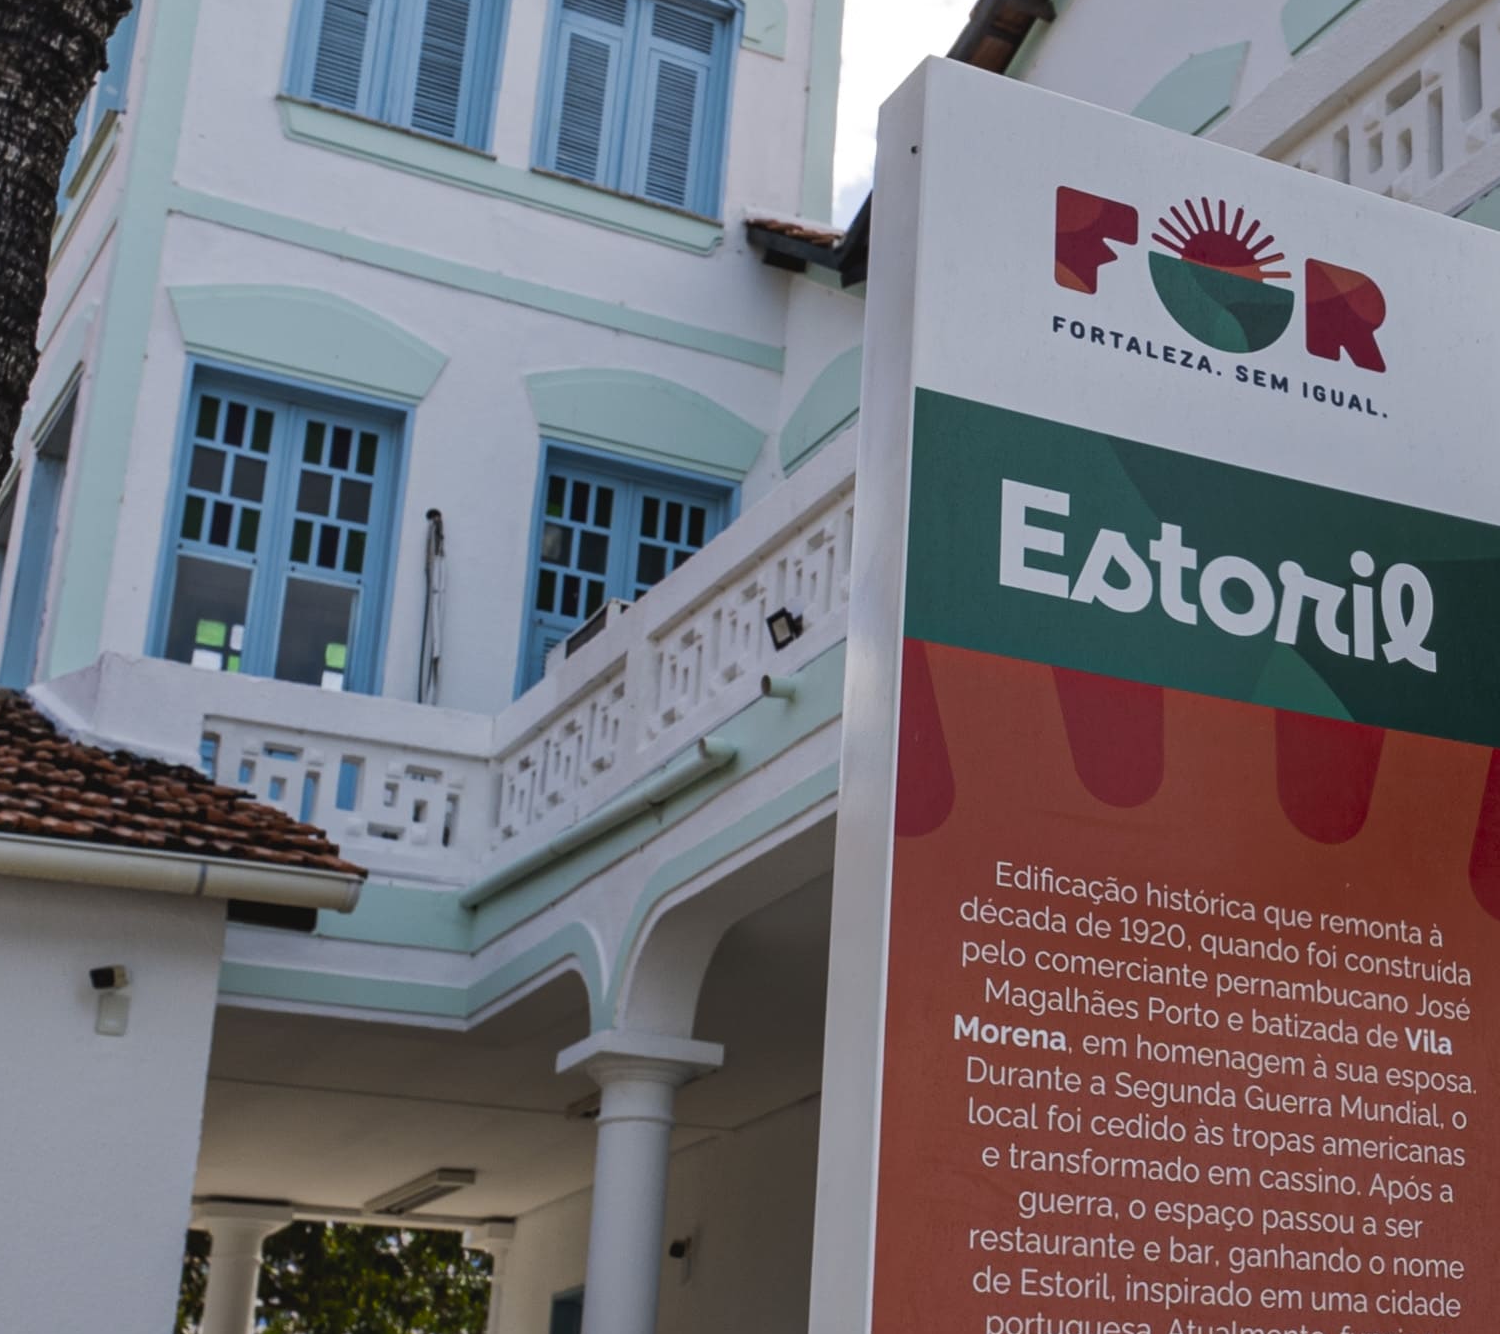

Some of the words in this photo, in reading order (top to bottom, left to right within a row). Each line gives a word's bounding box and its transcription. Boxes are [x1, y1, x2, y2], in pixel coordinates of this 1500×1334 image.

[1052, 316, 1222, 377] FORTALEZA.
[1235, 364, 1290, 394] SEM
[1301, 381, 1389, 418] IGUAL.
[999, 478, 1437, 673] Estoril
[959, 895, 1067, 934] década
[1075, 911, 1112, 939] de
[1119, 916, 1192, 952] 1920,
[1200, 933, 1300, 964] quando
[1306, 941, 1337, 969] foi
[1344, 953, 1472, 987] construída
[995, 860, 1138, 906] Edificação
[1146, 881, 1256, 922] histórica
[1263, 905, 1313, 931] que
[1320, 913, 1423, 945] remonta
[1429, 923, 1443, 948] à
[961, 938, 1027, 968] pelo
[1034, 950, 1209, 990] comerciante
[1216, 972, 1409, 1014] pernambucano
[1415, 993, 1471, 1022] José
[985, 977, 1139, 1020] Magalhães
[1148, 996, 1220, 1029] Porto
[1227, 1011, 1244, 1032] e
[1251, 1008, 1359, 1045] batizada
[1365, 1023, 1399, 1050] de
[1404, 1026, 1453, 1056] Vila
[953, 1013, 1073, 1055] Morena,
[1082, 1034, 1127, 1058] em
[1136, 1033, 1306, 1079] homenagem
[1312, 1053, 1328, 1079] à
[1335, 1061, 1379, 1084] sua
[1385, 1067, 1477, 1095] esposa.
[966, 1055, 1082, 1093] Durante
[1089, 1075, 1106, 1096] a
[1114, 1071, 1237, 1109] Segunda
[1244, 1084, 1333, 1118] Guerra
[1340, 1094, 1445, 1130] Mundial,
[1451, 1110, 1468, 1130] o
[968, 1096, 1039, 1130] local
[1046, 1104, 1082, 1134] foi
[1090, 1112, 1187, 1143] cedido
[1193, 1117, 1224, 1146] às
[1231, 1122, 1315, 1157] tropas
[1322, 1135, 1466, 1167] americanas
[981, 1146, 1001, 1168] e
[1008, 1142, 1200, 1184] transformado
[1207, 1165, 1251, 1188] em
[1259, 1167, 1361, 1196] cassino.
[1368, 1172, 1433, 1206] Após
[1439, 1183, 1454, 1204] a
[969, 1226, 1136, 1260] restaurante
[1143, 1241, 1162, 1262] e
[1169, 1235, 1220, 1267] bar,
[1228, 1242, 1362, 1274] ganhando
[1368, 1255, 1386, 1275] o
[1393, 1256, 1465, 1280] nome
[1018, 1190, 1119, 1220] guerra,
[1128, 1198, 1147, 1220] o
[1154, 1201, 1254, 1232] espaço
[1262, 1209, 1355, 1235] passou
[1362, 1216, 1377, 1236] a
[1384, 1217, 1424, 1239] ser
[972, 1264, 1012, 1295] de
[1020, 1267, 1116, 1303] Estoril,
[1126, 1273, 1253, 1311] inspirado
[1259, 1288, 1303, 1310] em
[1311, 1291, 1369, 1313] uma
[1375, 1288, 1462, 1318] cidade
